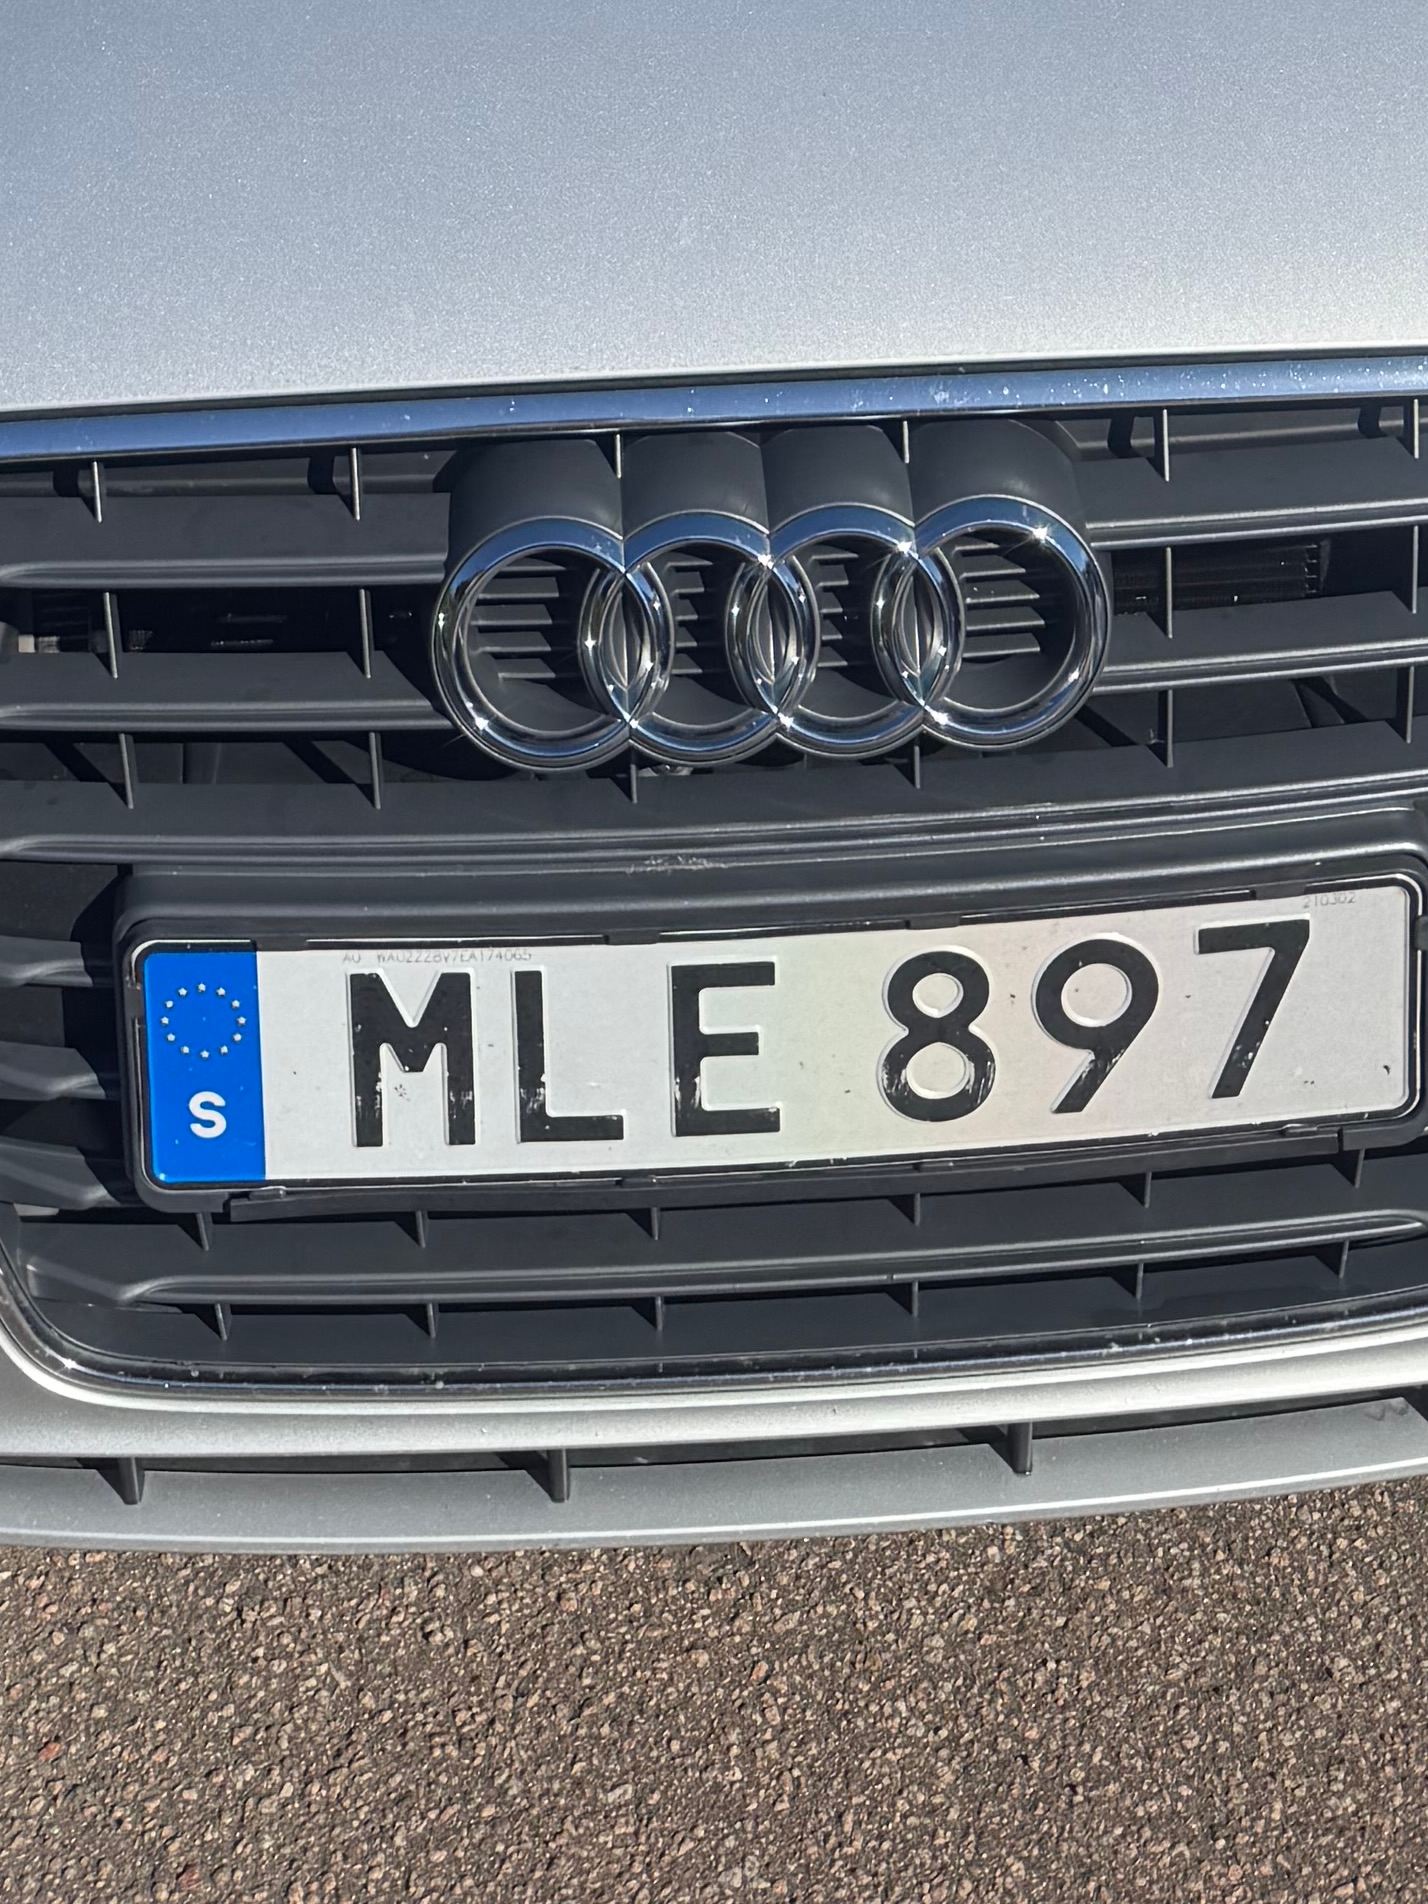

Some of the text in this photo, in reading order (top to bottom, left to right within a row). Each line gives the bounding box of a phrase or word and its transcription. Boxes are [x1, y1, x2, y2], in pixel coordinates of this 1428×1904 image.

[350, 919, 1312, 1147] MLE 897
[190, 1090, 226, 1139] S
